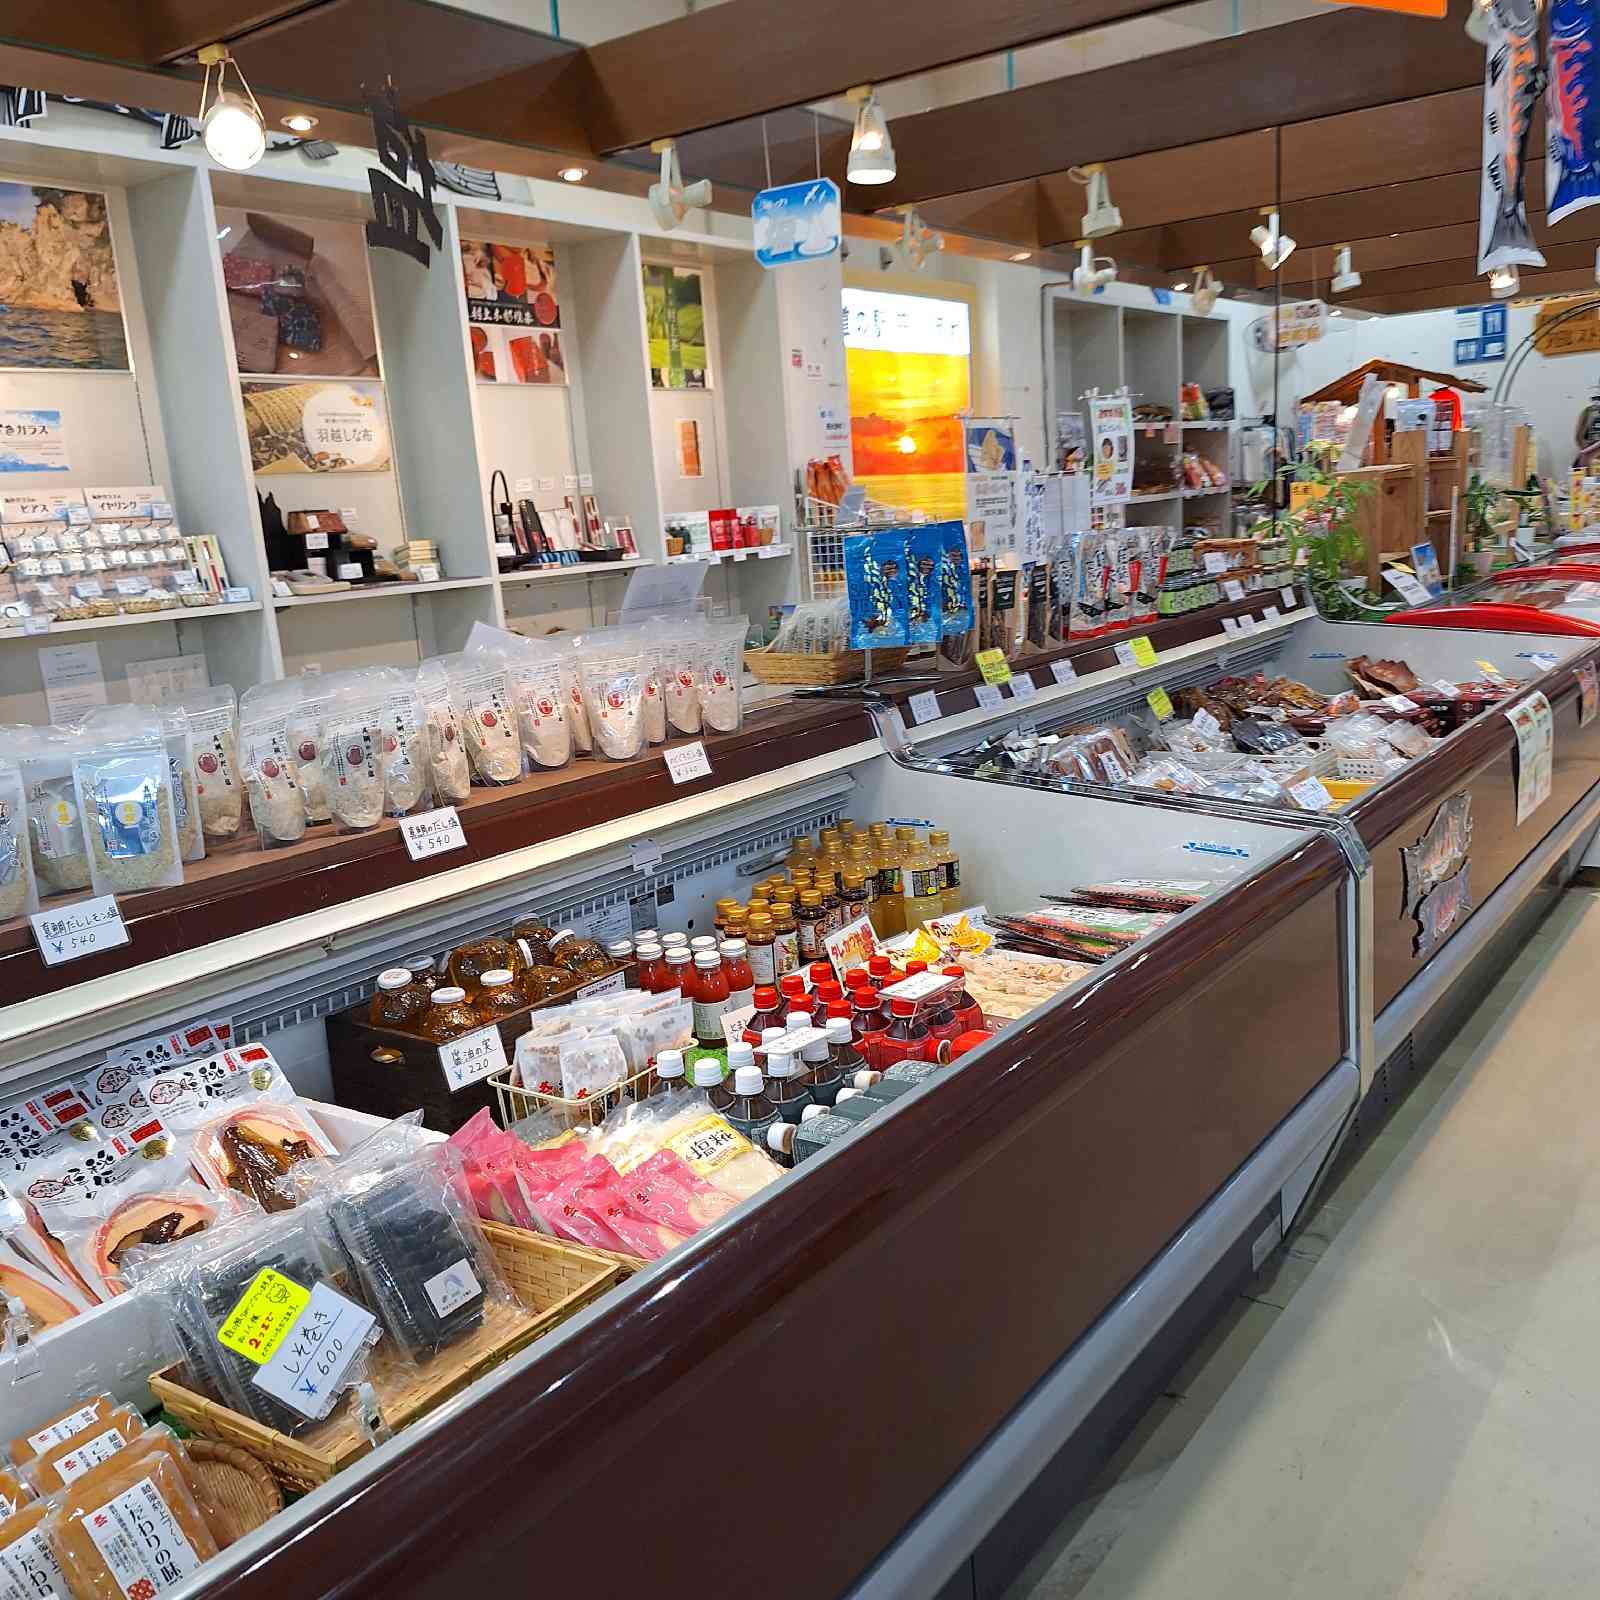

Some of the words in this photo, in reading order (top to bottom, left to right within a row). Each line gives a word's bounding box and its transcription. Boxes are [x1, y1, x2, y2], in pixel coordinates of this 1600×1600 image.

[283, 1311, 332, 1374] しそ巻き
[123, 1493, 184, 1587] こだわりの味
